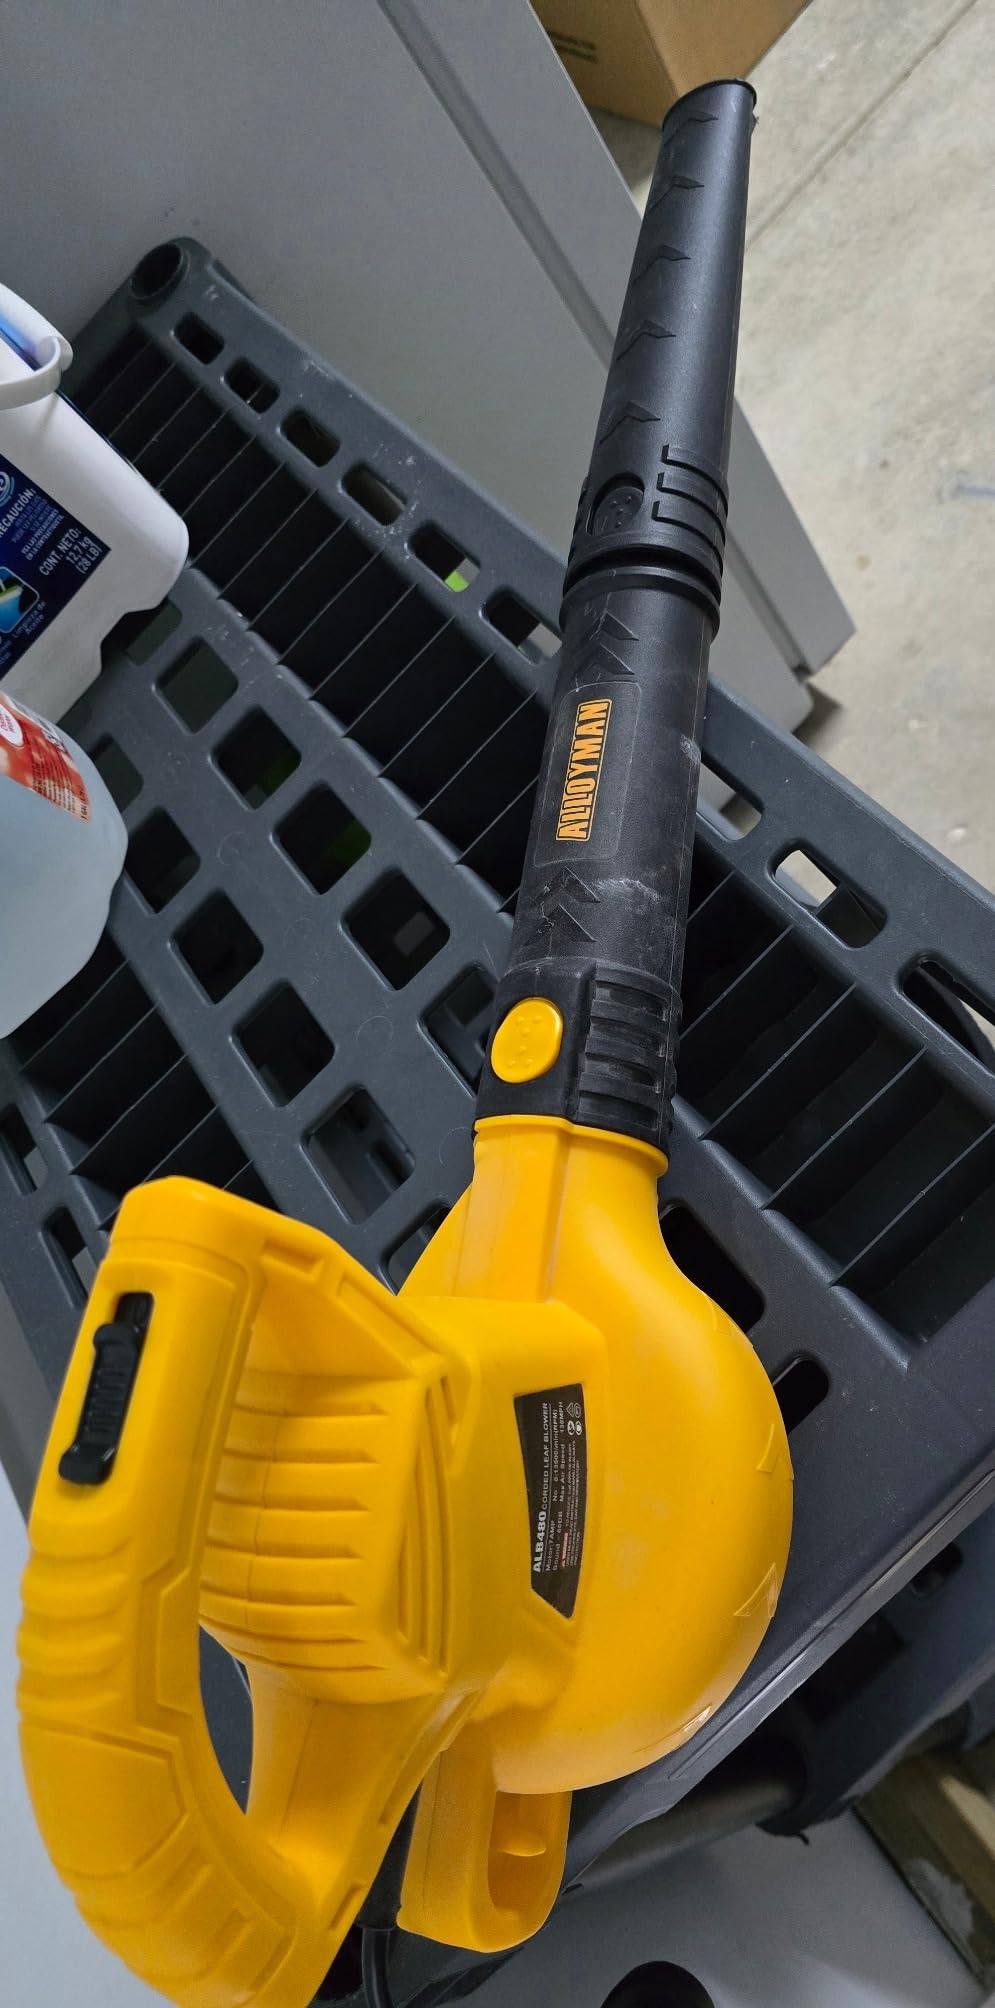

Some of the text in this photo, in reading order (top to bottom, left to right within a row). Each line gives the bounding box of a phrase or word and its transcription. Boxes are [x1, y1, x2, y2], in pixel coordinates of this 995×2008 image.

[39, 528, 81, 576] CONT. NETO:
[75, 544, 103, 574] (28 LB)
[78, 536, 93, 549] kg
[557, 699, 611, 841] ALLOYMAN
[533, 1511, 546, 1573] ALB480
